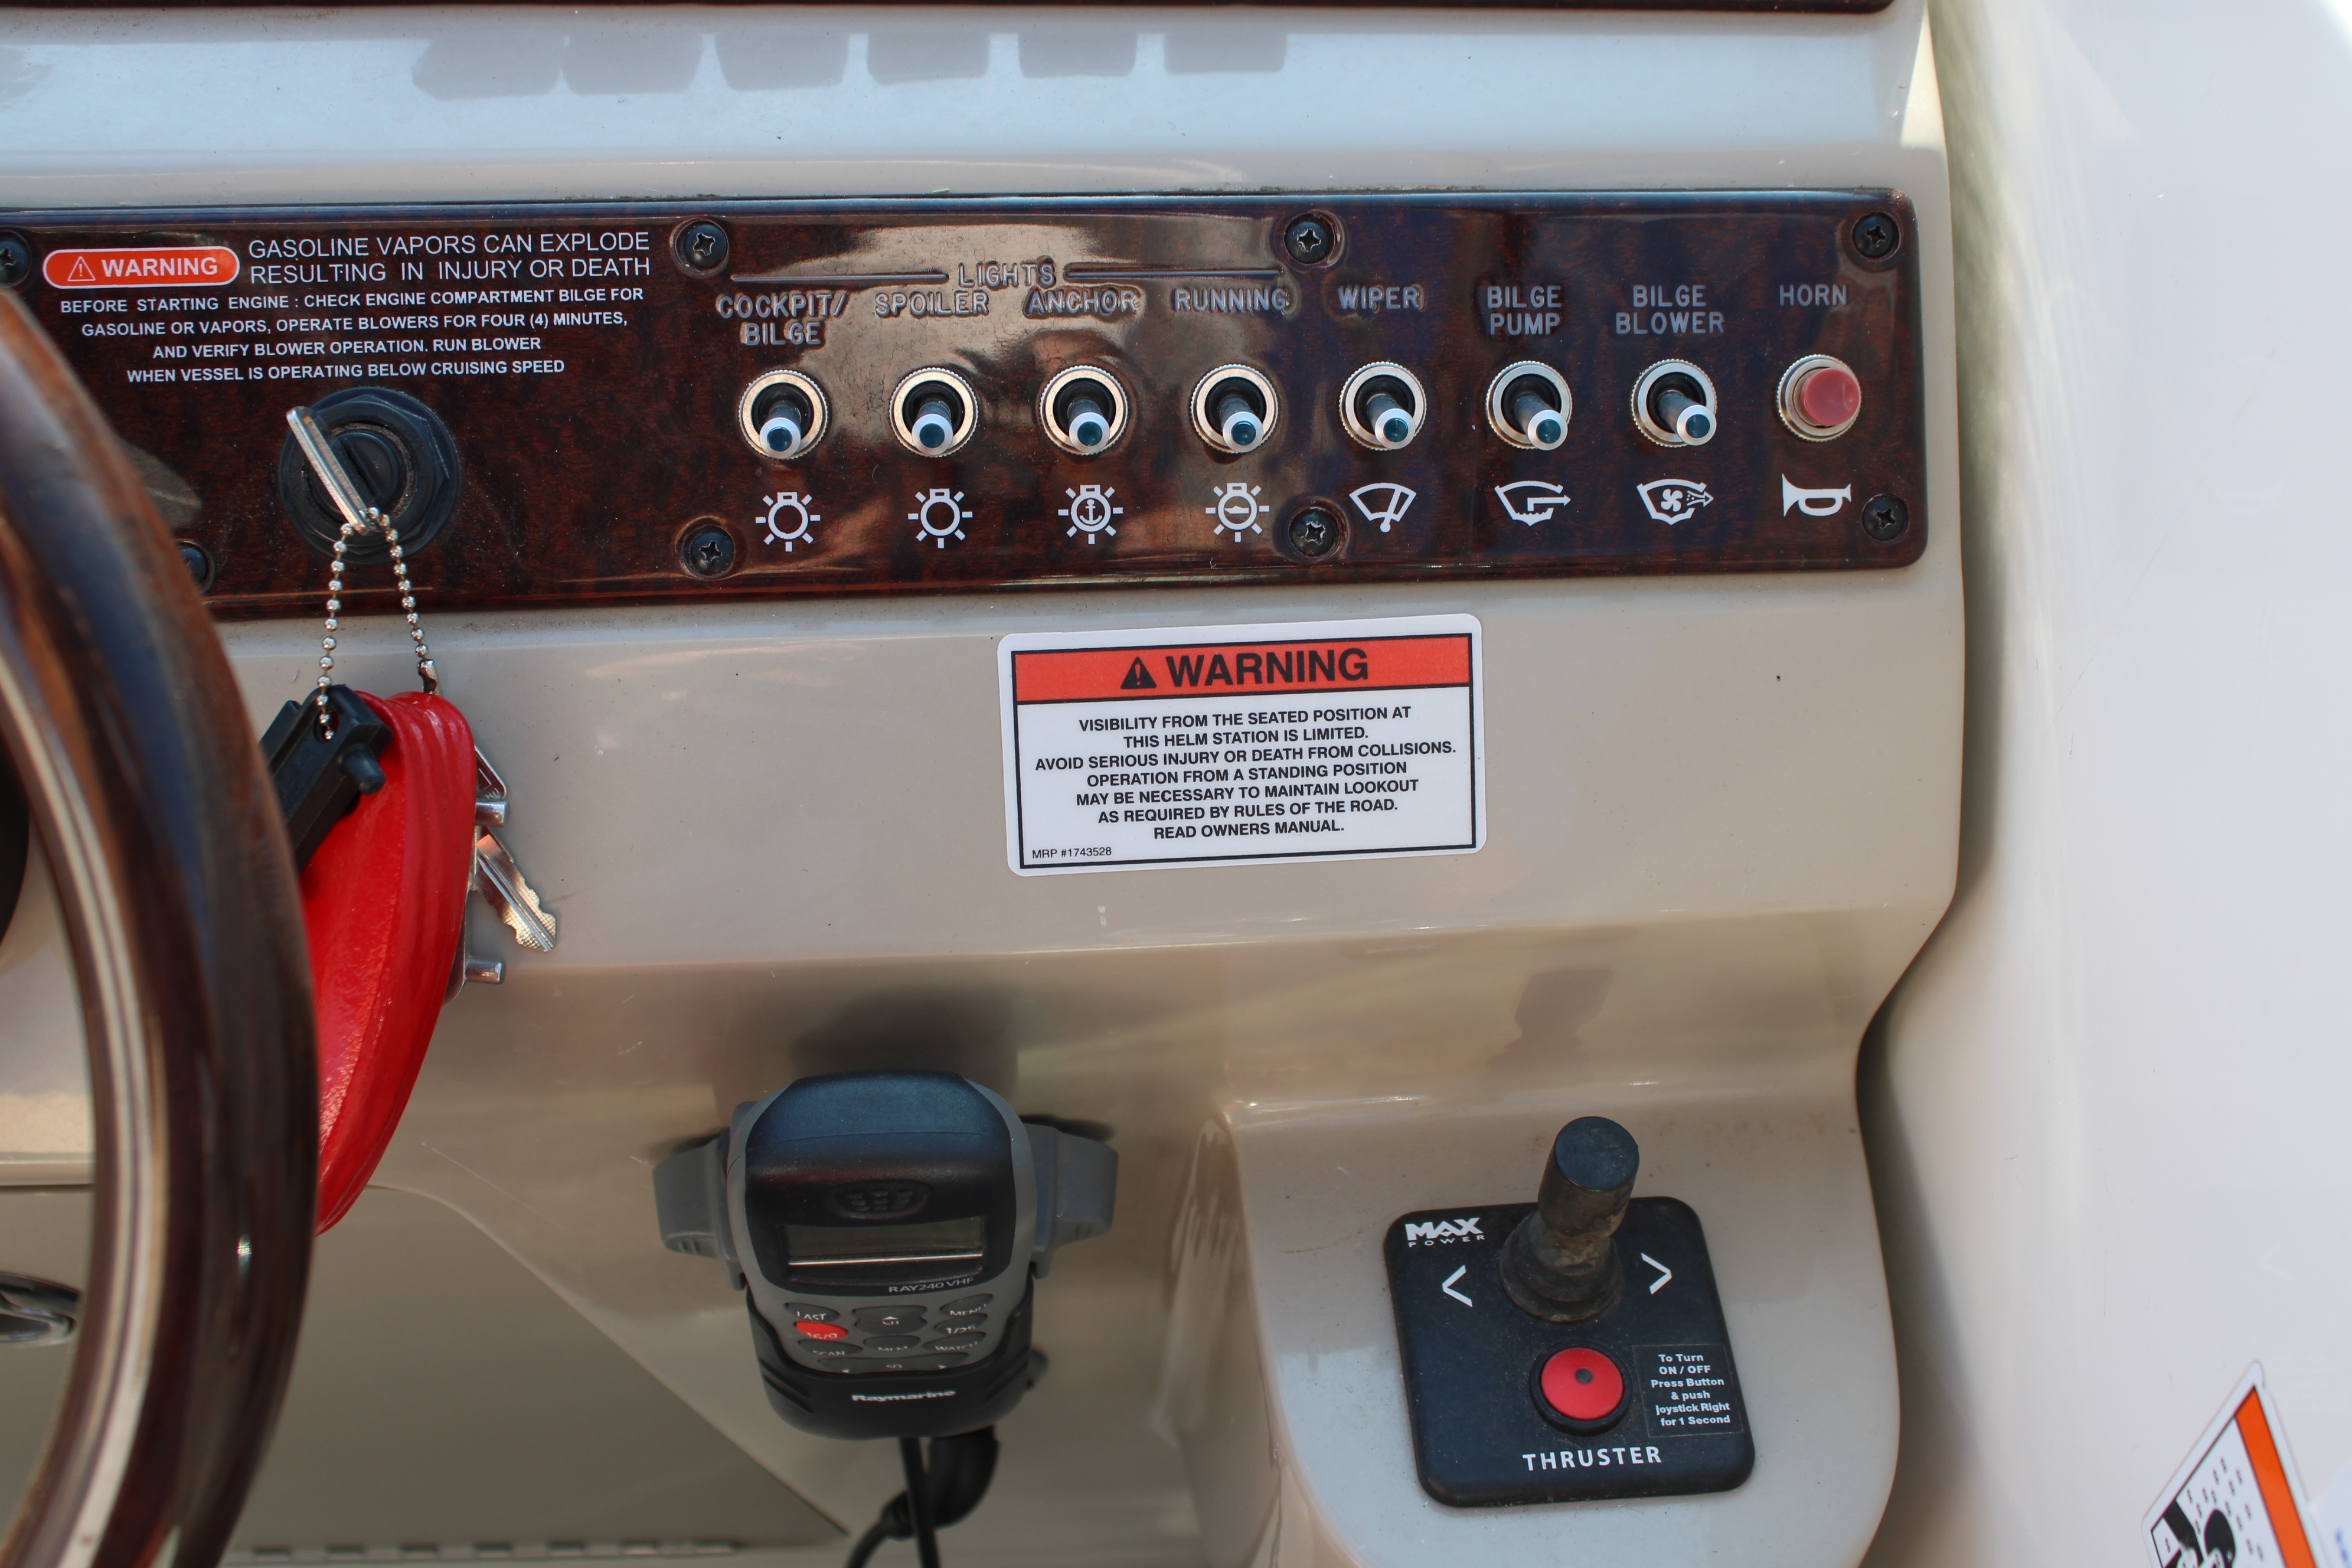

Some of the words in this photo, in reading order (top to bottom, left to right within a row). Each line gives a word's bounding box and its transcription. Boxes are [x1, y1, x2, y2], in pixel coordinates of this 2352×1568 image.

[249, 238, 368, 258] GASOLINE
[377, 236, 475, 254] VAPORS
[484, 234, 531, 253] CAN
[541, 232, 649, 251] EXPLODE
[102, 257, 217, 277] WARNING
[251, 263, 386, 284] RESULTING
[402, 262, 423, 280] IN
[439, 260, 522, 279] INJURY
[530, 259, 564, 277] OR
[572, 257, 649, 276] DEATH
[958, 263, 1056, 288] LIGHTS
[61, 300, 127, 312] BEFORE
[138, 298, 218, 311] STARTING
[229, 296, 289, 309] ENGINE
[305, 294, 360, 307] CHECK
[366, 293, 425, 306] ENGINE
[431, 290, 554, 304] COMPARTMENT
[559, 289, 606, 301] BILGE
[611, 288, 643, 300] FOR
[720, 293, 847, 319] COCKPIT/
[875, 292, 988, 317] SPOILER
[1028, 290, 1136, 313] ANCHOR
[1175, 288, 1287, 311] RUNNING
[1338, 287, 1418, 310] WIPER
[1488, 286, 1561, 308] BILGE
[1634, 285, 1706, 307] BILGE
[1779, 285, 1848, 306] HORN
[82, 322, 165, 336] GASOLINE
[171, 322, 194, 334] OR
[199, 320, 270, 334] VAPORS,
[277, 318, 352, 331] OPERATE
[359, 316, 438, 329] BLOWERS
[444, 315, 476, 327] FOR
[482, 314, 525, 326] FOUR
[530, 313, 548, 329] (4)
[554, 312, 627, 326] MINUTES,
[745, 322, 822, 346] BILGE
[1491, 313, 1560, 335] PUMP
[1616, 312, 1724, 334] BLOWER
[153, 346, 187, 358] AND
[192, 344, 249, 357] VERIFY
[255, 342, 325, 355] BLOWER
[330, 340, 427, 354] OPERATION.
[433, 339, 466, 351] RUN
[472, 338, 541, 351] BLOWER
[128, 370, 175, 382] WHEN
[181, 368, 243, 381] VESSEL
[249, 367, 263, 379] IS
[269, 365, 362, 378] OPERATING
[368, 363, 426, 376] BELOW
[431, 361, 507, 375] CRUISING
[512, 360, 564, 373] SPEED
[1165, 648, 1368, 687] WARNING
[1079, 717, 1157, 731] VISIBILITY
[1163, 715, 1207, 728] FROM
[1213, 713, 1243, 726] THE
[1248, 711, 1308, 724] SEATED
[1314, 707, 1387, 721] POSITION
[1393, 707, 1411, 718] AT
[1123, 736, 1159, 748] THIS
[1165, 733, 1207, 746] HELM
[1213, 730, 1278, 744] STATION
[1285, 730, 1298, 741] IS
[1304, 727, 1368, 740] LIMITED.
[1035, 757, 1083, 770] AVOID
[1089, 754, 1158, 768] SERIOUS
[1164, 752, 1219, 765] INJURY
[1224, 750, 1246, 762] OR
[1252, 748, 1302, 761] DEATH
[1309, 746, 1353, 759] FROM
[1358, 741, 1455, 757] COLLISIONS.
[1087, 772, 1178, 786] OPERATION
[1184, 770, 1228, 782] FROM
[1234, 769, 1244, 780] A
[1249, 765, 1328, 780] STANDING
[1334, 762, 1406, 776] POSITION
[1077, 793, 1109, 805] MAY
[1114, 792, 1134, 803] BE
[1139, 788, 1234, 803] NECESSARY
[1239, 786, 1259, 798] TO
[1265, 783, 1339, 797] MAINTAIN
[1345, 779, 1419, 794] LOOKOUT
[1099, 811, 1119, 823] AS
[1125, 808, 1204, 822] REQUIRED
[1210, 806, 1229, 818] BY
[1234, 803, 1285, 817] RULES
[1290, 803, 1310, 815] OF
[1315, 801, 1345, 813] THE
[1351, 799, 1397, 812] ROAD.
[1154, 826, 1196, 839] READ
[1201, 822, 1270, 837] OWNERS
[1275, 820, 1344, 834] MANUAL.
[1033, 849, 1057, 858] MRP
[1061, 847, 1112, 857] #1743528
[1405, 1218, 1484, 1242] MAX
[1409, 1235, 1484, 1247] POWER
[888, 1282, 944, 1292] RAY240
[946, 1277, 974, 1286] VHF
[851, 1391, 957, 1402] Raymarine
[1682, 1390, 1710, 1401] push
[1701, 1403, 1730, 1412] Right
[1688, 1415, 1730, 1424] Second
[1523, 1446, 1661, 1471] THRUSTER
